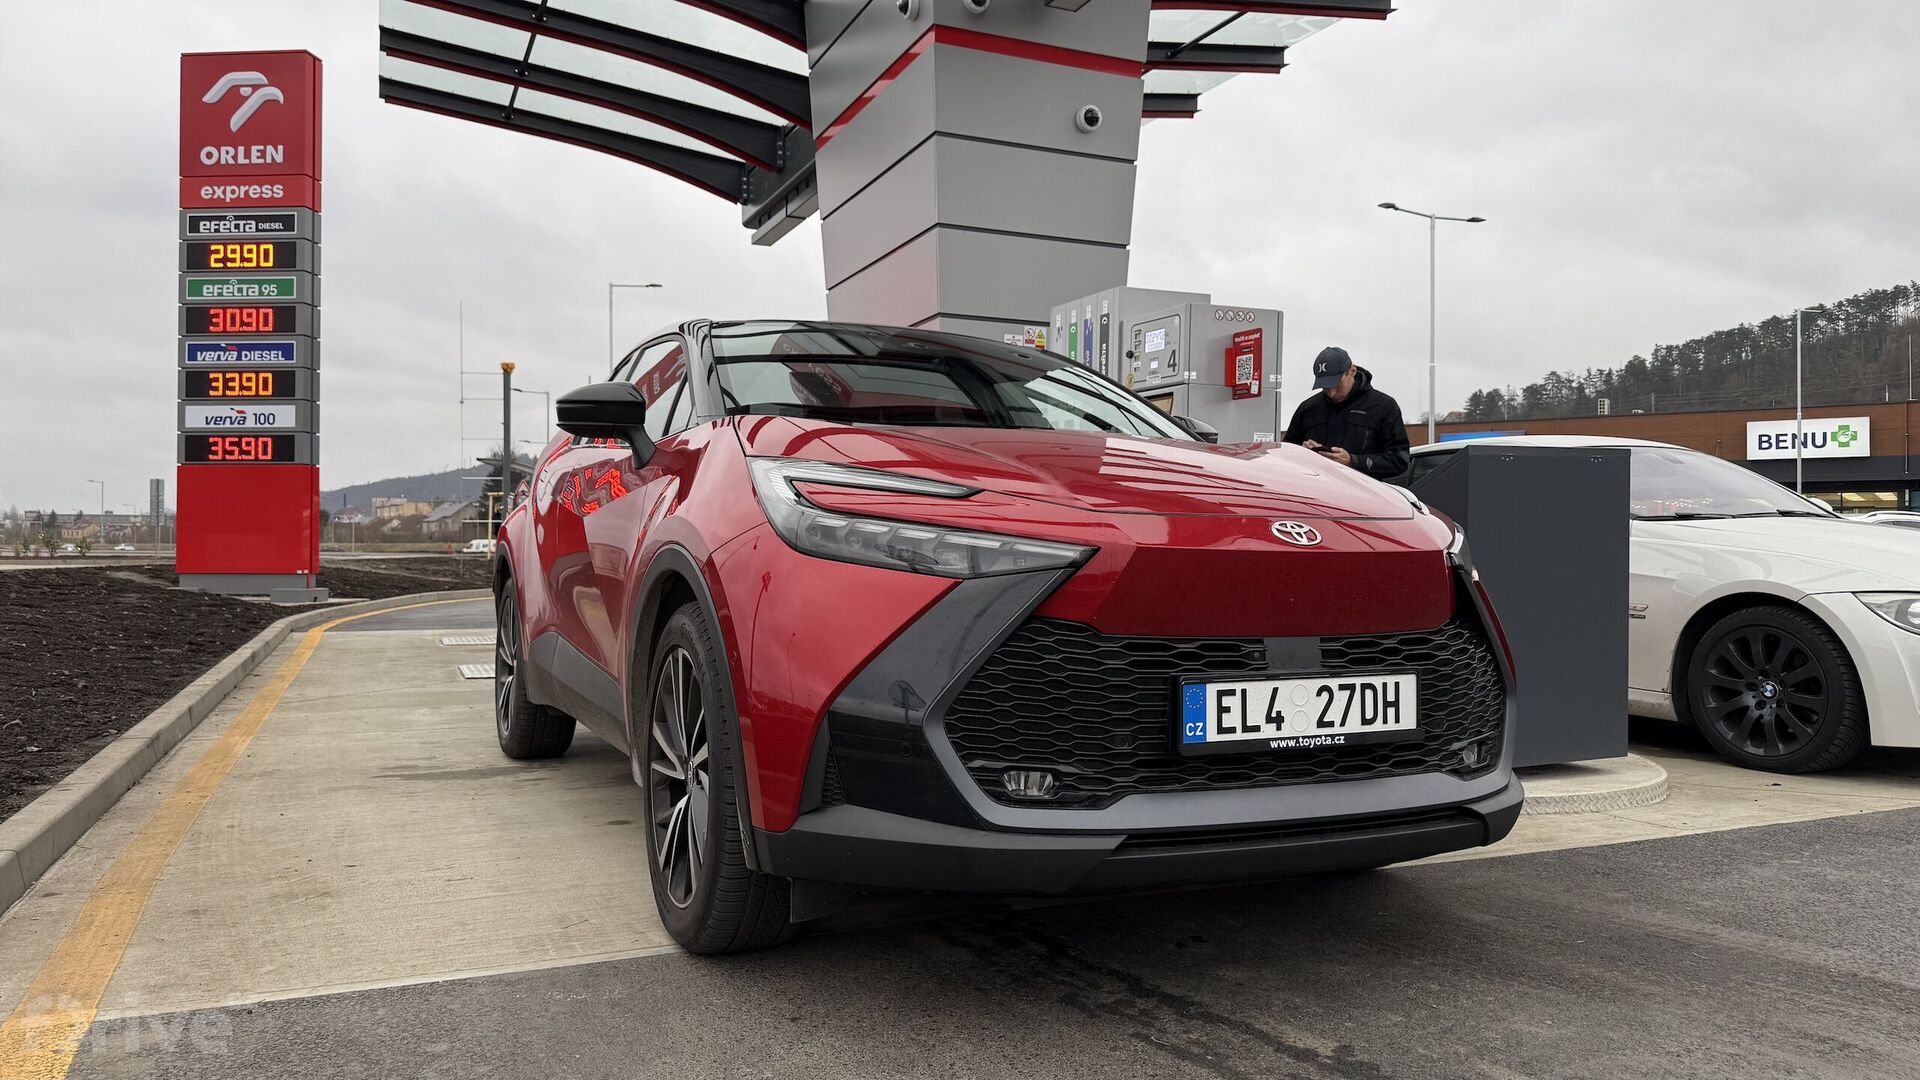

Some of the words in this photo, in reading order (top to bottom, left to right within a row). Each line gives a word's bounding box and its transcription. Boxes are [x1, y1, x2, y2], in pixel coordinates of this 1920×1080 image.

[200, 145, 284, 165] ORLEN
[200, 184, 284, 202] express
[258, 222, 284, 230] DIESEL
[210, 243, 274, 267] 29.90
[261, 284, 278, 296] 95
[208, 308, 273, 332] 30.90
[197, 350, 238, 361] verva
[241, 350, 285, 361] DIESEL
[1167, 349, 1177, 372] 4
[208, 372, 273, 396] 33.90
[204, 413, 247, 426] verva
[252, 412, 276, 426] 100
[208, 437, 272, 460] 35.90
[1757, 431, 1828, 451] BENU
[1216, 686, 1285, 735] EL4
[1315, 681, 1401, 729] 27DH
[1186, 722, 1204, 737] CZ
[1269, 735, 1346, 749] www.toyota.cz
